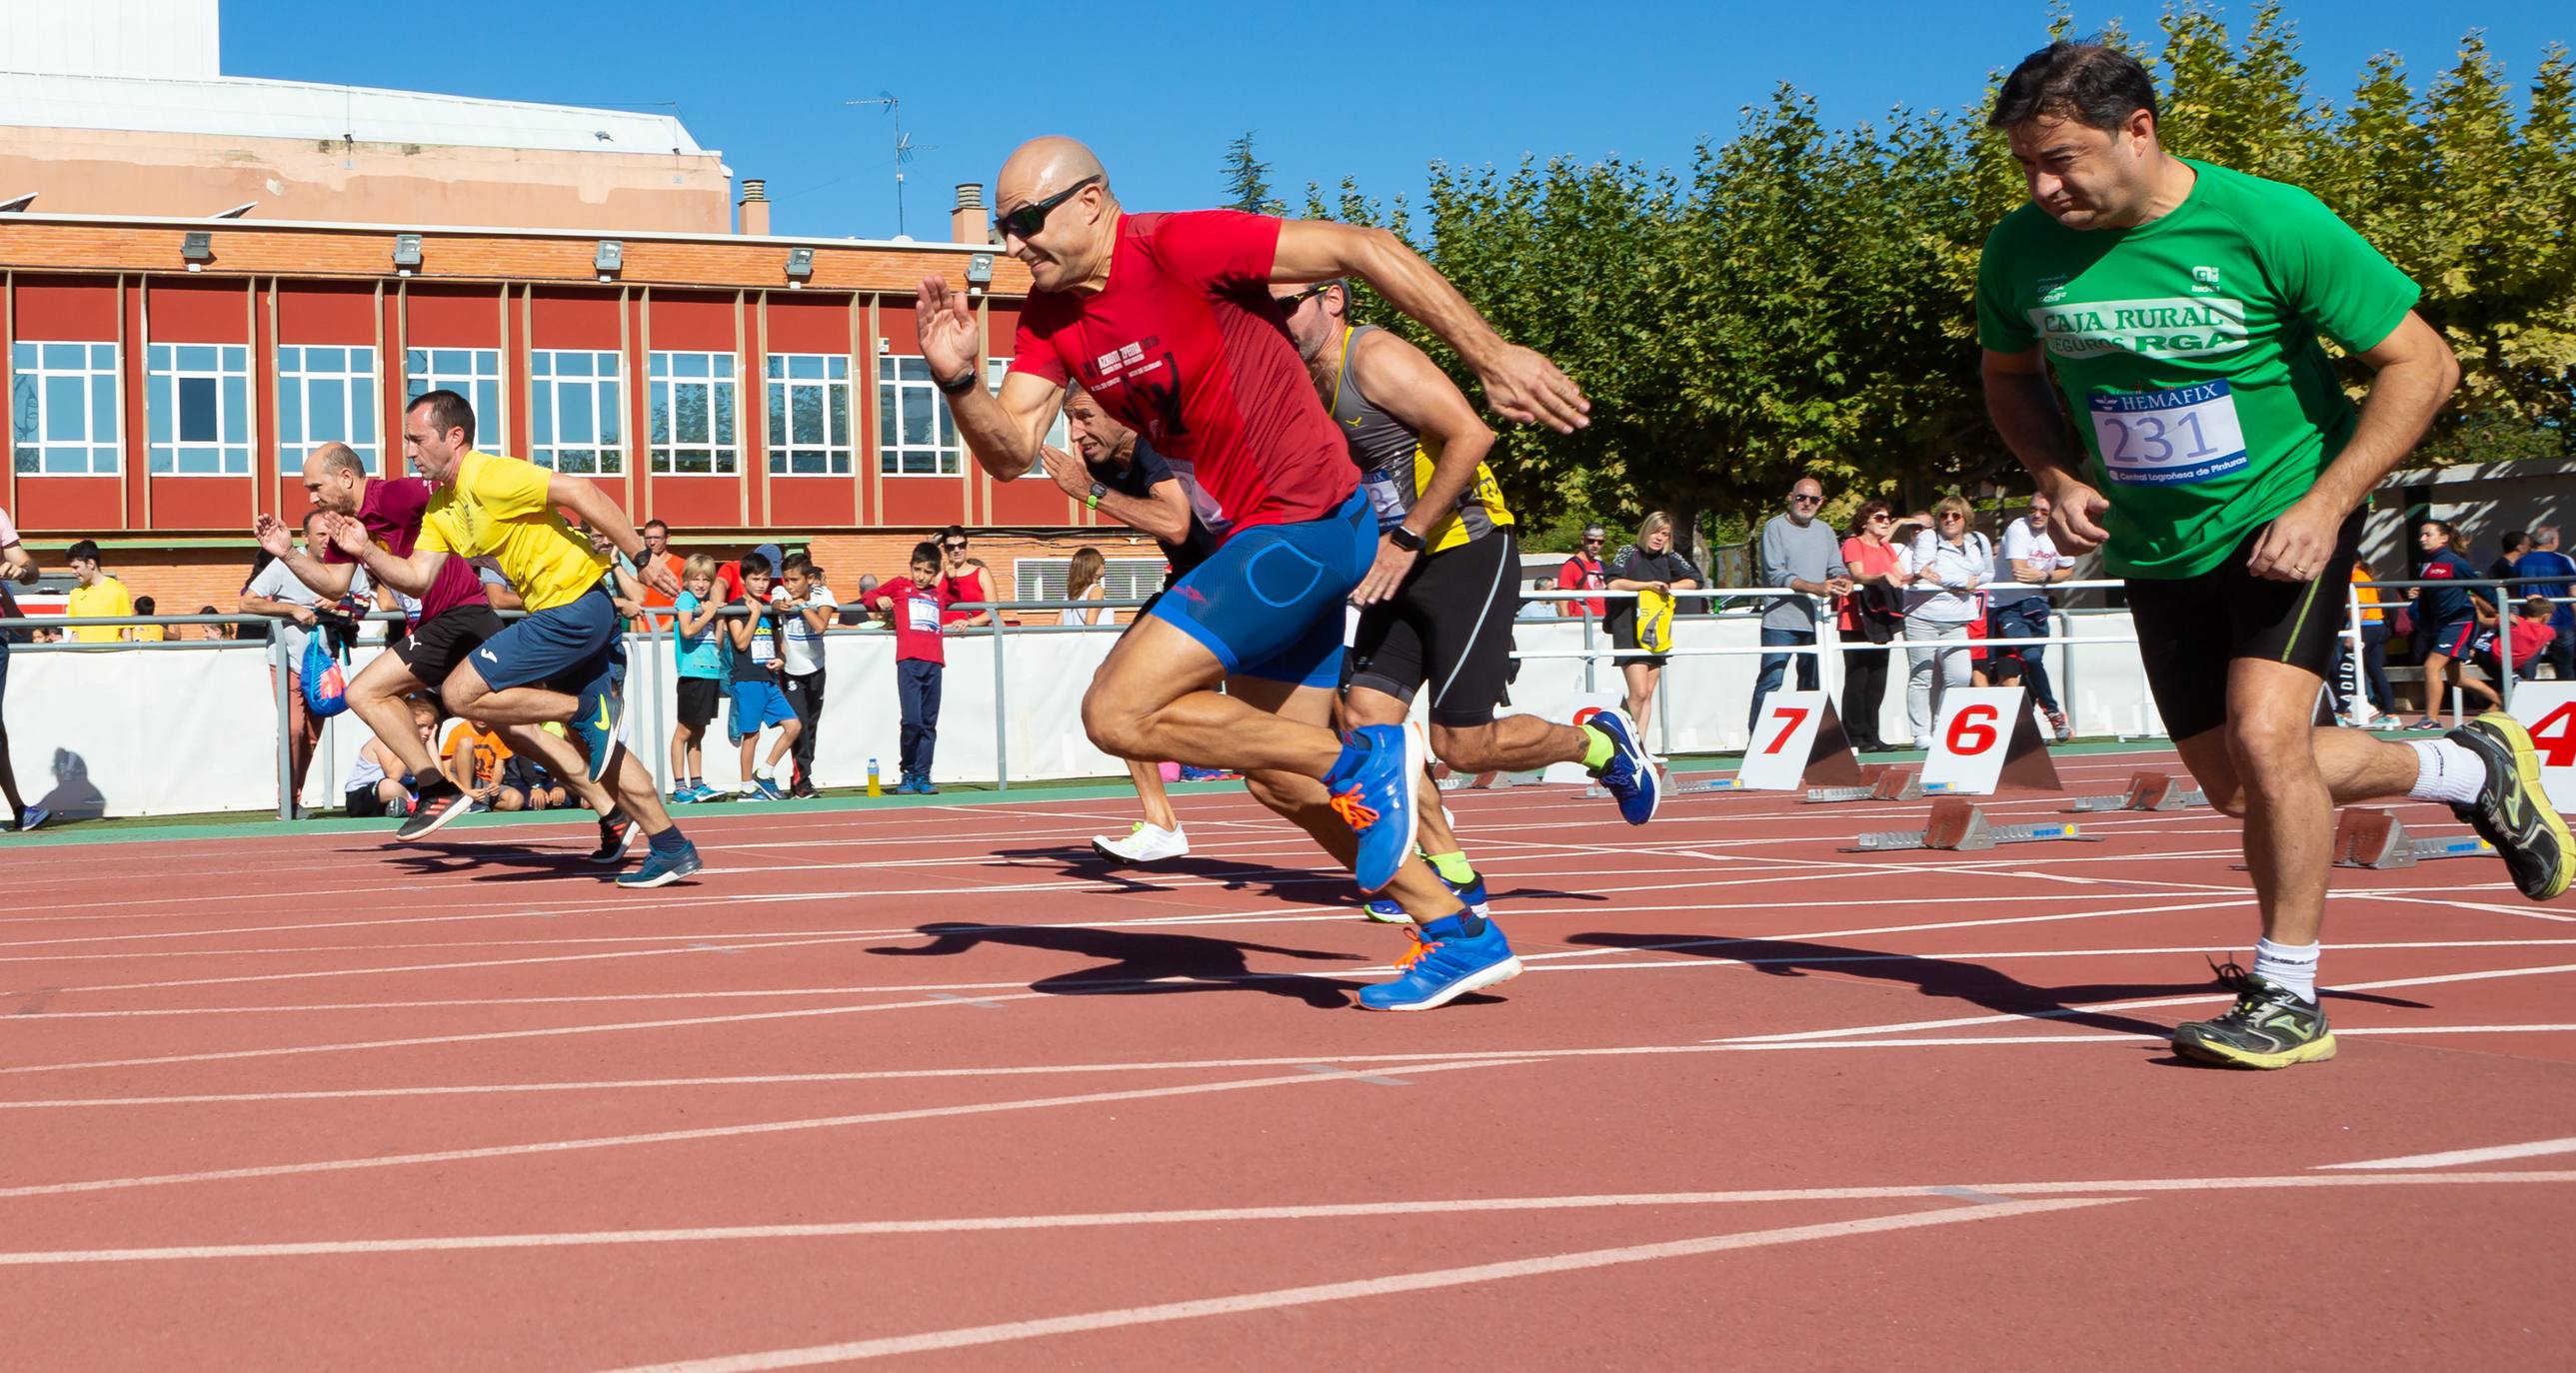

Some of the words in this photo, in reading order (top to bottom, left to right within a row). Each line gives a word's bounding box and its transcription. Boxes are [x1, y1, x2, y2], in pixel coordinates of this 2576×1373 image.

[2044, 311, 2107, 334] CAJA
[2114, 306, 2224, 330] RURAL
[2135, 332, 2235, 353] RGA
[2121, 383, 2219, 411] HEMAFIX
[2104, 411, 2219, 463] 231
[2120, 472, 2148, 482] Central
[2148, 471, 2194, 483] Logroñesa
[2196, 467, 2209, 476] de
[2210, 456, 2248, 473] Pinturas
[1763, 706, 1810, 754] 7
[1945, 703, 1998, 756] 6
[2527, 700, 2576, 767] 4
